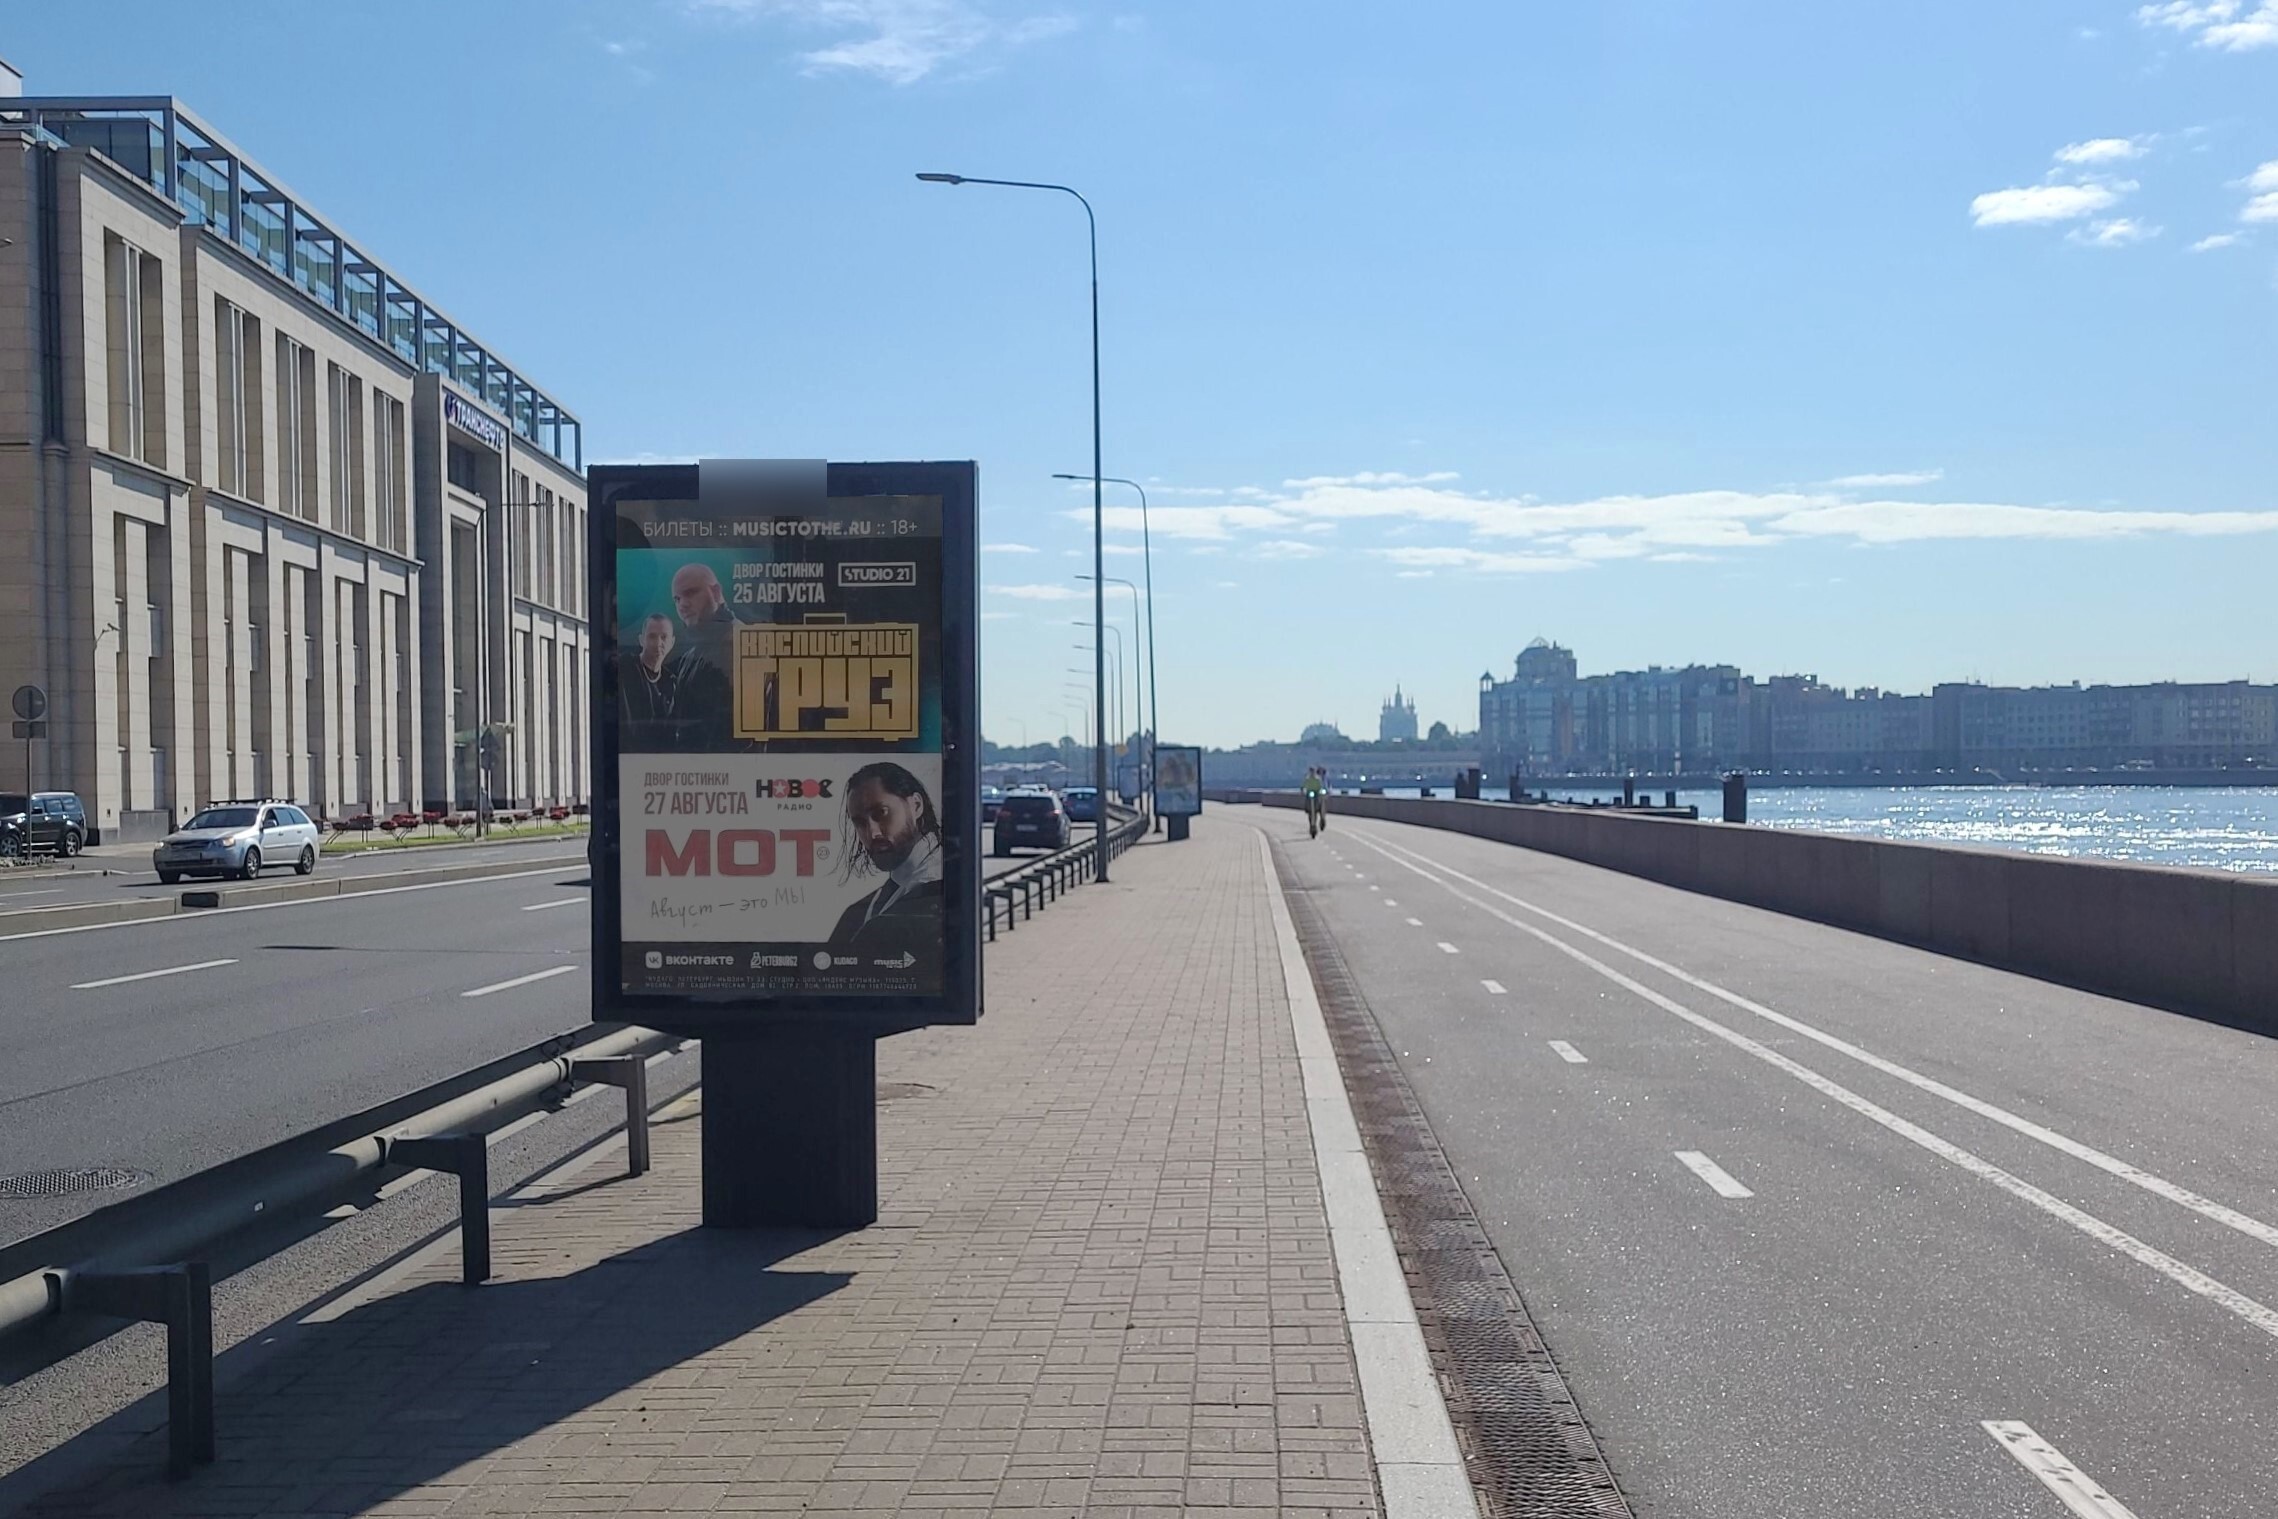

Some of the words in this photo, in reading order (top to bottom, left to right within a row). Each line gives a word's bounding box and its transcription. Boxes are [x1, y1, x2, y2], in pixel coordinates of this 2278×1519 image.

[643, 521, 713, 537] БИЛЕТЫ
[733, 520, 871, 536] MUSICTOTHE.RU
[890, 519, 918, 535] 18+
[732, 563, 765, 580] ДВОР
[766, 562, 824, 578] ГОСТИНКИ
[844, 568, 893, 581] STUDIO
[896, 567, 910, 580] 21
[733, 583, 753, 604] 25
[757, 582, 826, 603] АВГУСТА
[741, 630, 912, 656] КАСПИЙСКИЙ
[741, 657, 912, 731] ГРУЗ
[644, 773, 673, 787] ДВОР
[675, 772, 729, 786] ГОСТИНКИ
[644, 792, 665, 815] 27
[670, 791, 749, 815] АВГУСТА
[777, 803, 813, 812] РАДИО
[645, 829, 831, 877] МОТ
[650, 897, 713, 927] Август
[739, 899, 768, 911] это
[775, 887, 805, 906] МЫ
